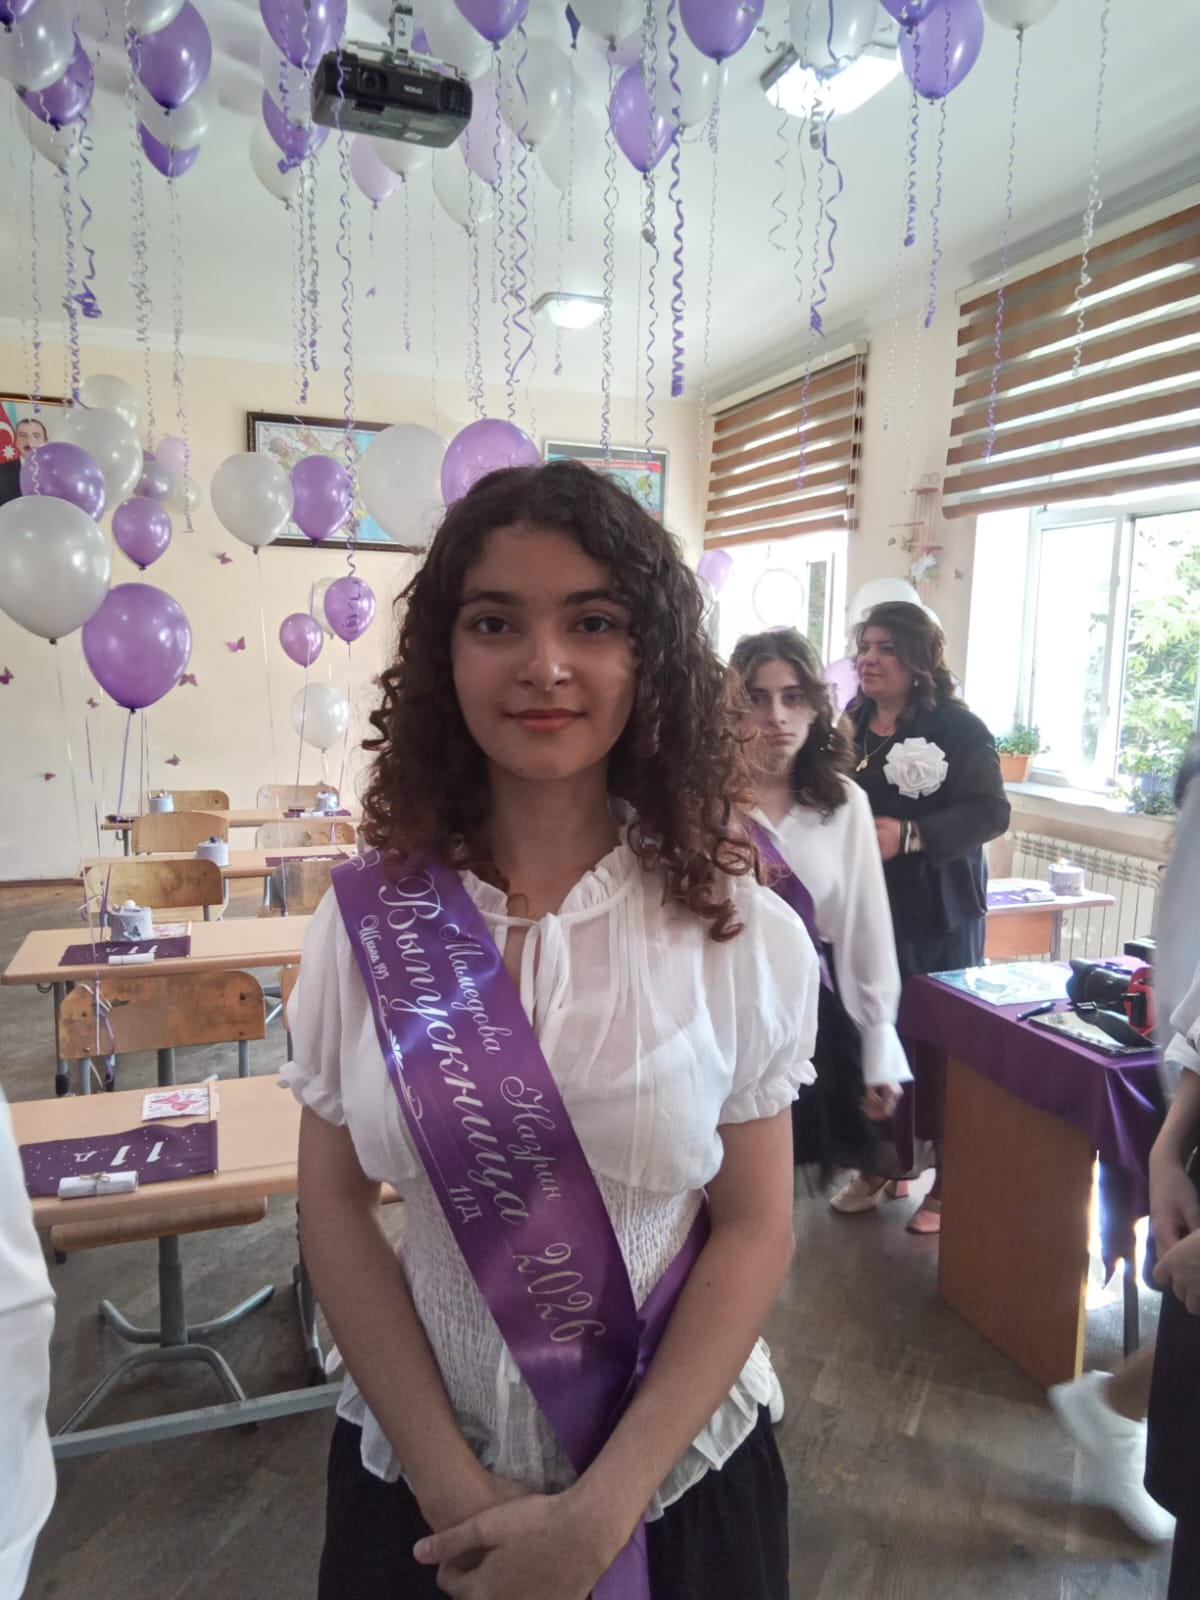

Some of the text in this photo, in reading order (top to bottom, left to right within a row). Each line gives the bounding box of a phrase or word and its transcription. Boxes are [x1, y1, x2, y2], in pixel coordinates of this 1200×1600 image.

[378, 869, 530, 1224] Выпускница
[439, 923, 562, 1199] Мамедова Назрин
[450, 1185, 483, 1223] 11Д
[512, 1242, 606, 1342] 2026
